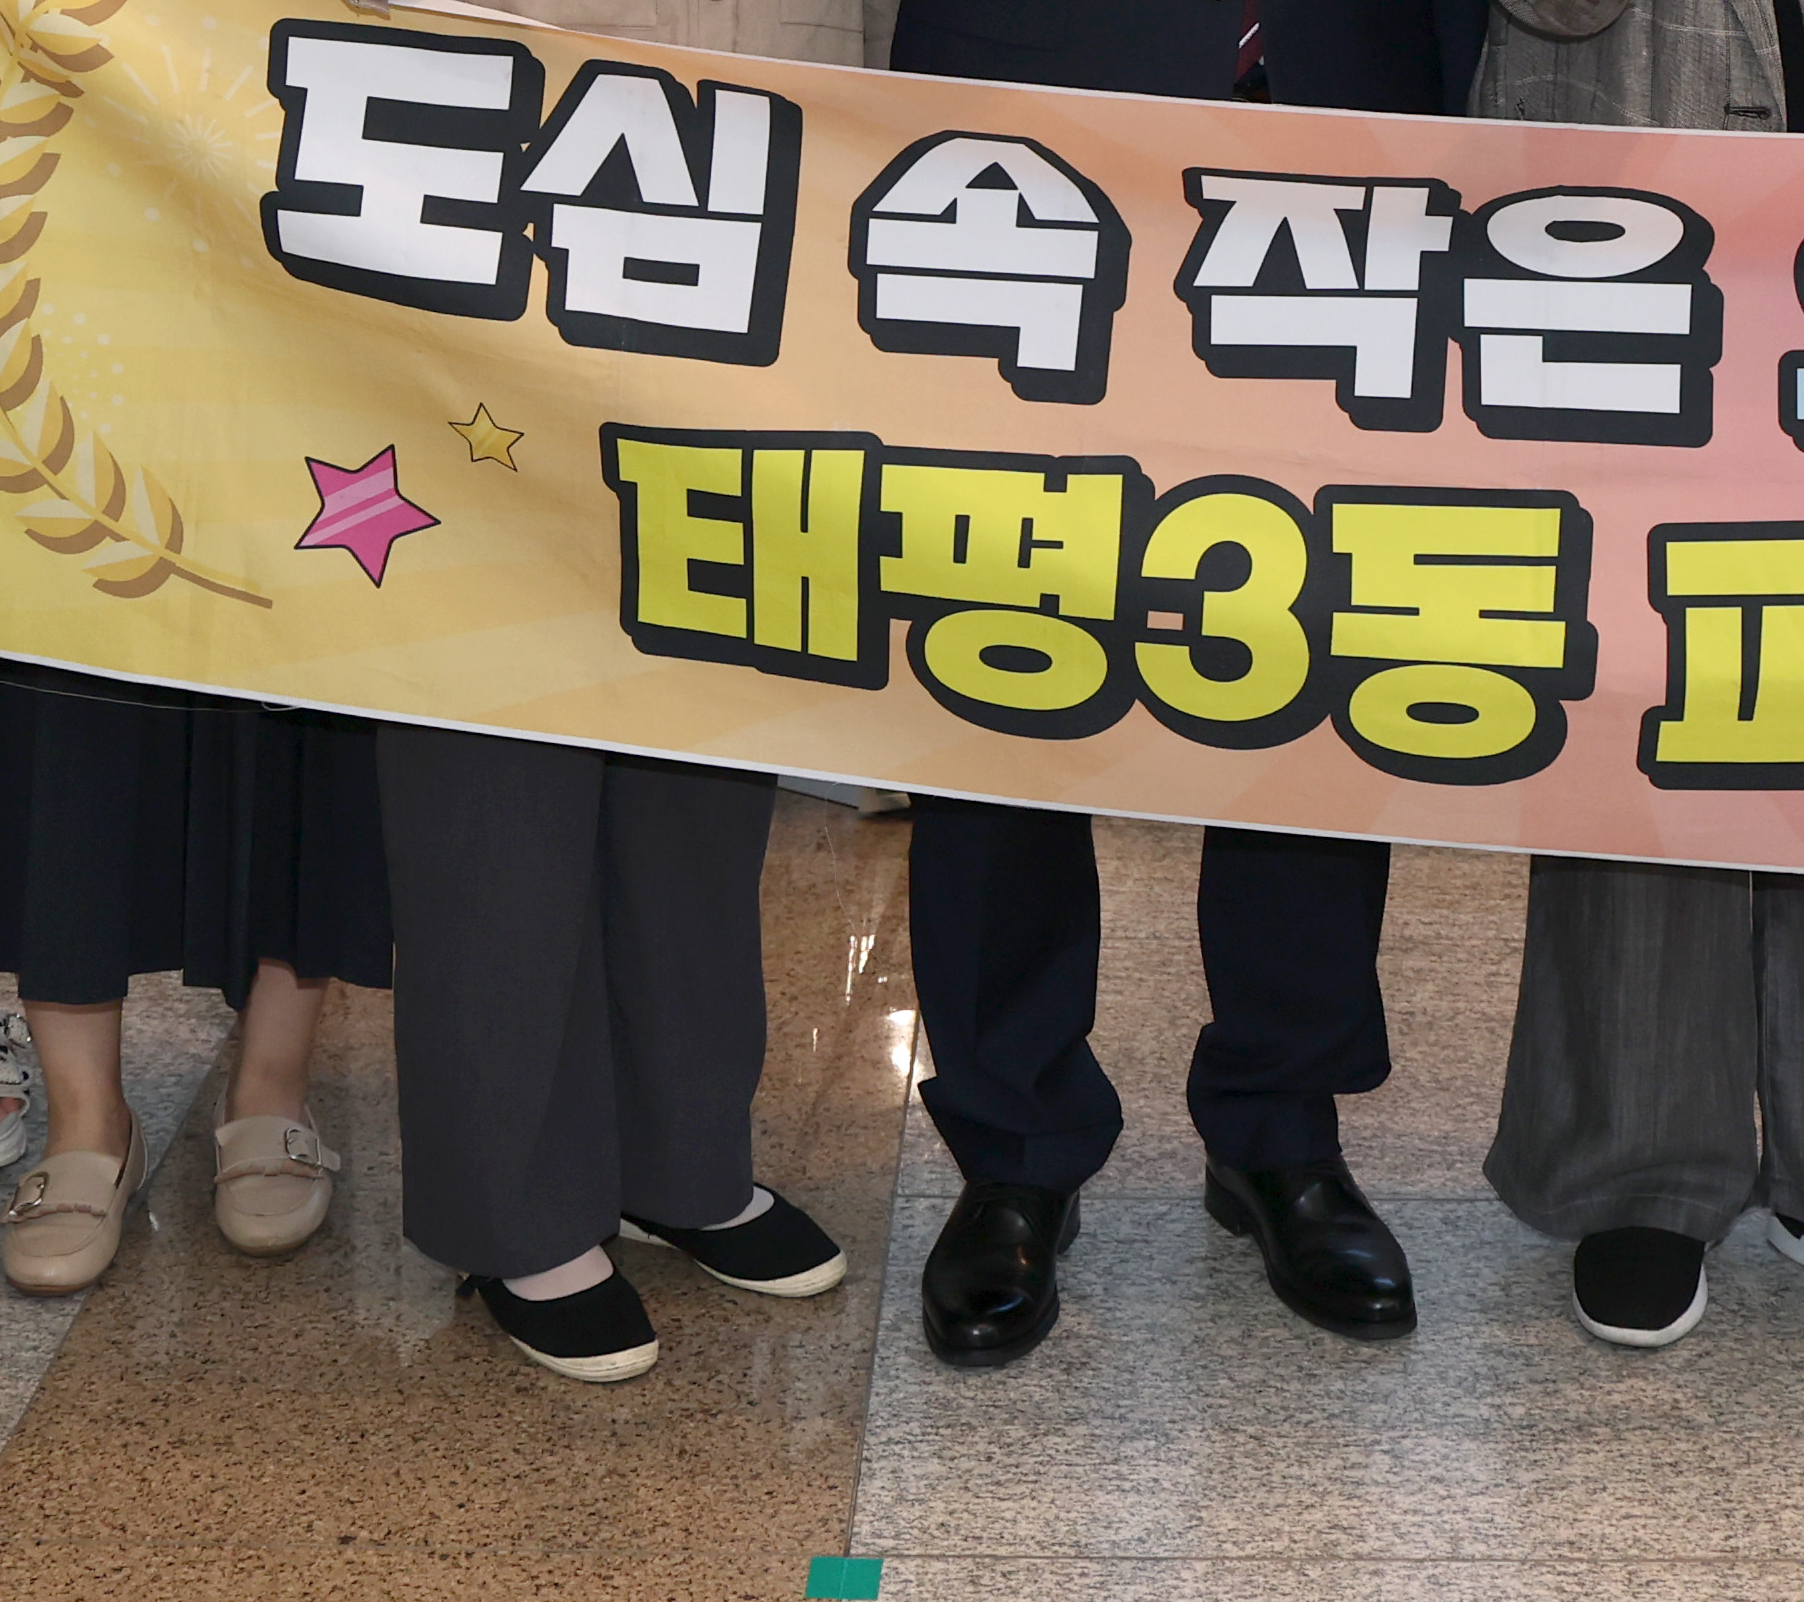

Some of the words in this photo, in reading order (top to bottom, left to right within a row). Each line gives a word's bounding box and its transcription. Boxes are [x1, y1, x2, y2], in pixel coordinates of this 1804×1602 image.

[267, 17, 800, 367] 도심
[850, 130, 1129, 403] 속
[1184, 167, 1724, 449] 작은
[600, 422, 1595, 783] 태평3동
